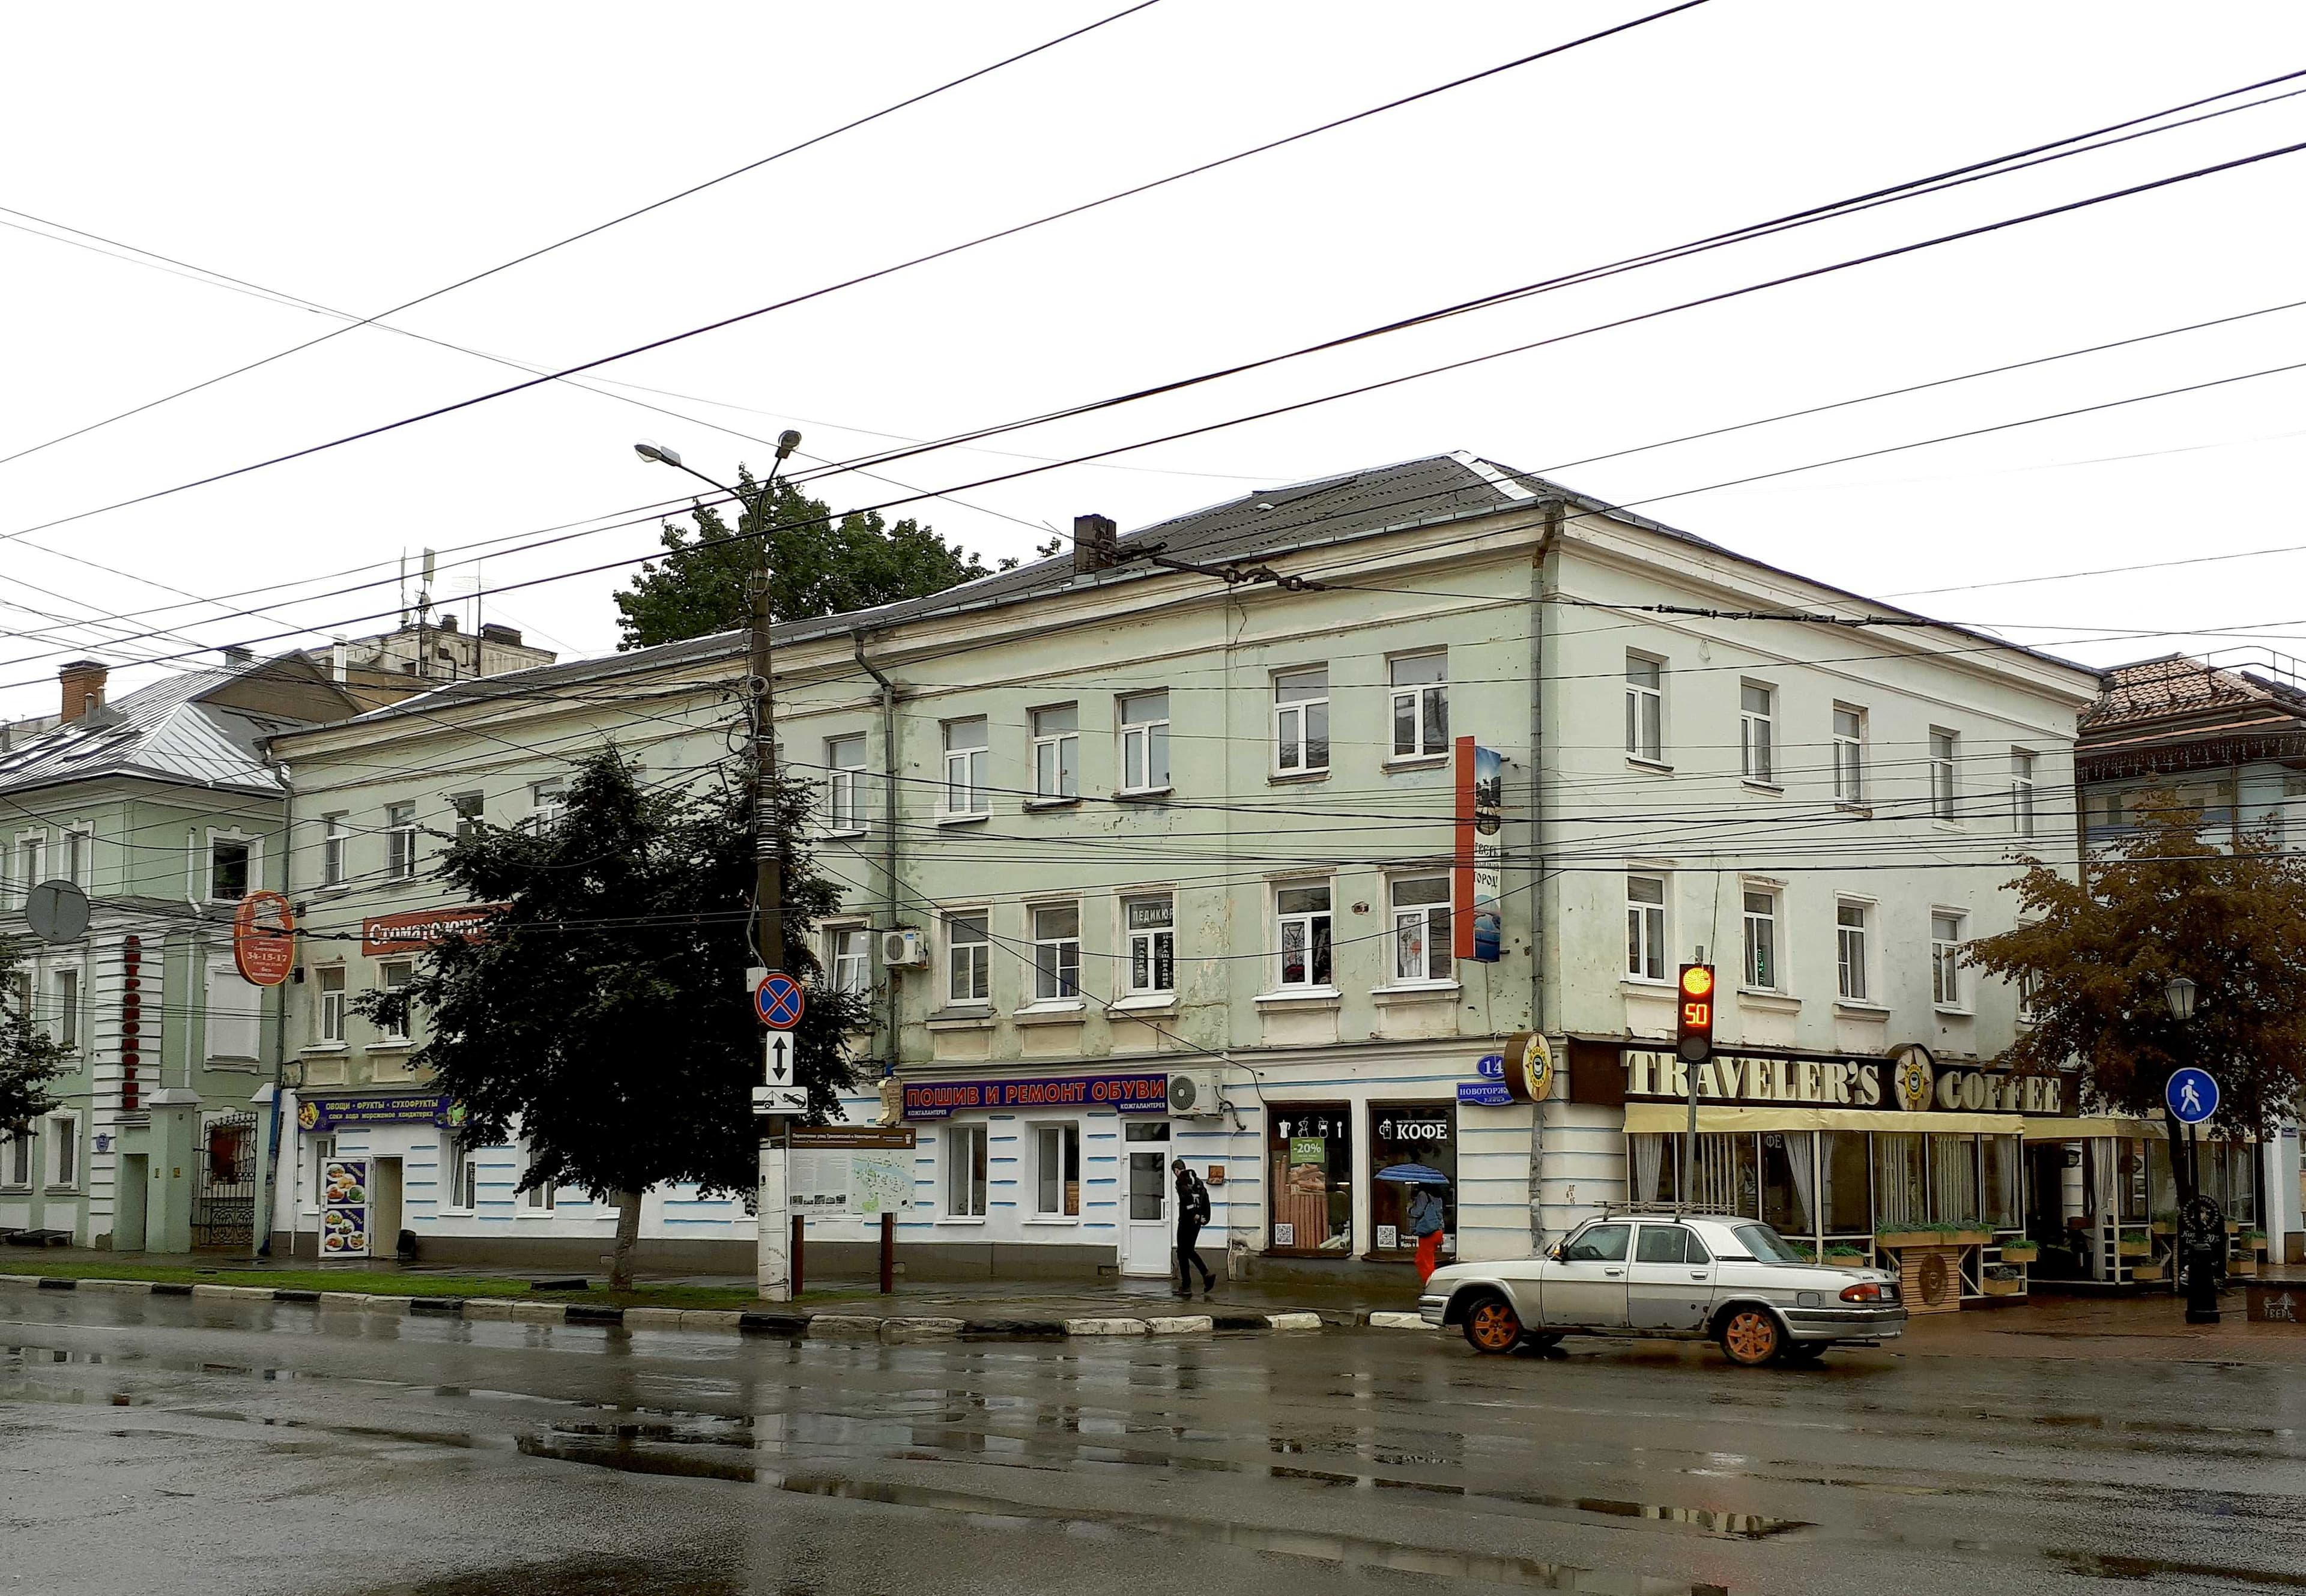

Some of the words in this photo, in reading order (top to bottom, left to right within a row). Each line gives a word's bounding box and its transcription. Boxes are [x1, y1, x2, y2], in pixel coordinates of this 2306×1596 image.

[1133, 908, 1173, 923] ПЕДИКЮР
[1685, 1003, 1707, 1024] 50
[1484, 1059, 1504, 1074] 14
[1620, 1050, 1881, 1105] TRAVELER'S
[907, 1087, 979, 1107] ПОШИВ
[985, 1086, 999, 1105] И
[1005, 1082, 1086, 1104] РЕМОНТ
[1092, 1079, 1165, 1101] ОБУВИ
[1937, 1071, 2061, 1113] COFFEE
[325, 1102, 351, 1111] ОВОЩИ
[357, 1101, 384, 1109] ФРУКТЫ
[392, 1099, 438, 1108] СУХОФРУКТЫ
[1396, 1124, 1447, 1140] КОФЕ
[1294, 1143, 1321, 1153] -20%
